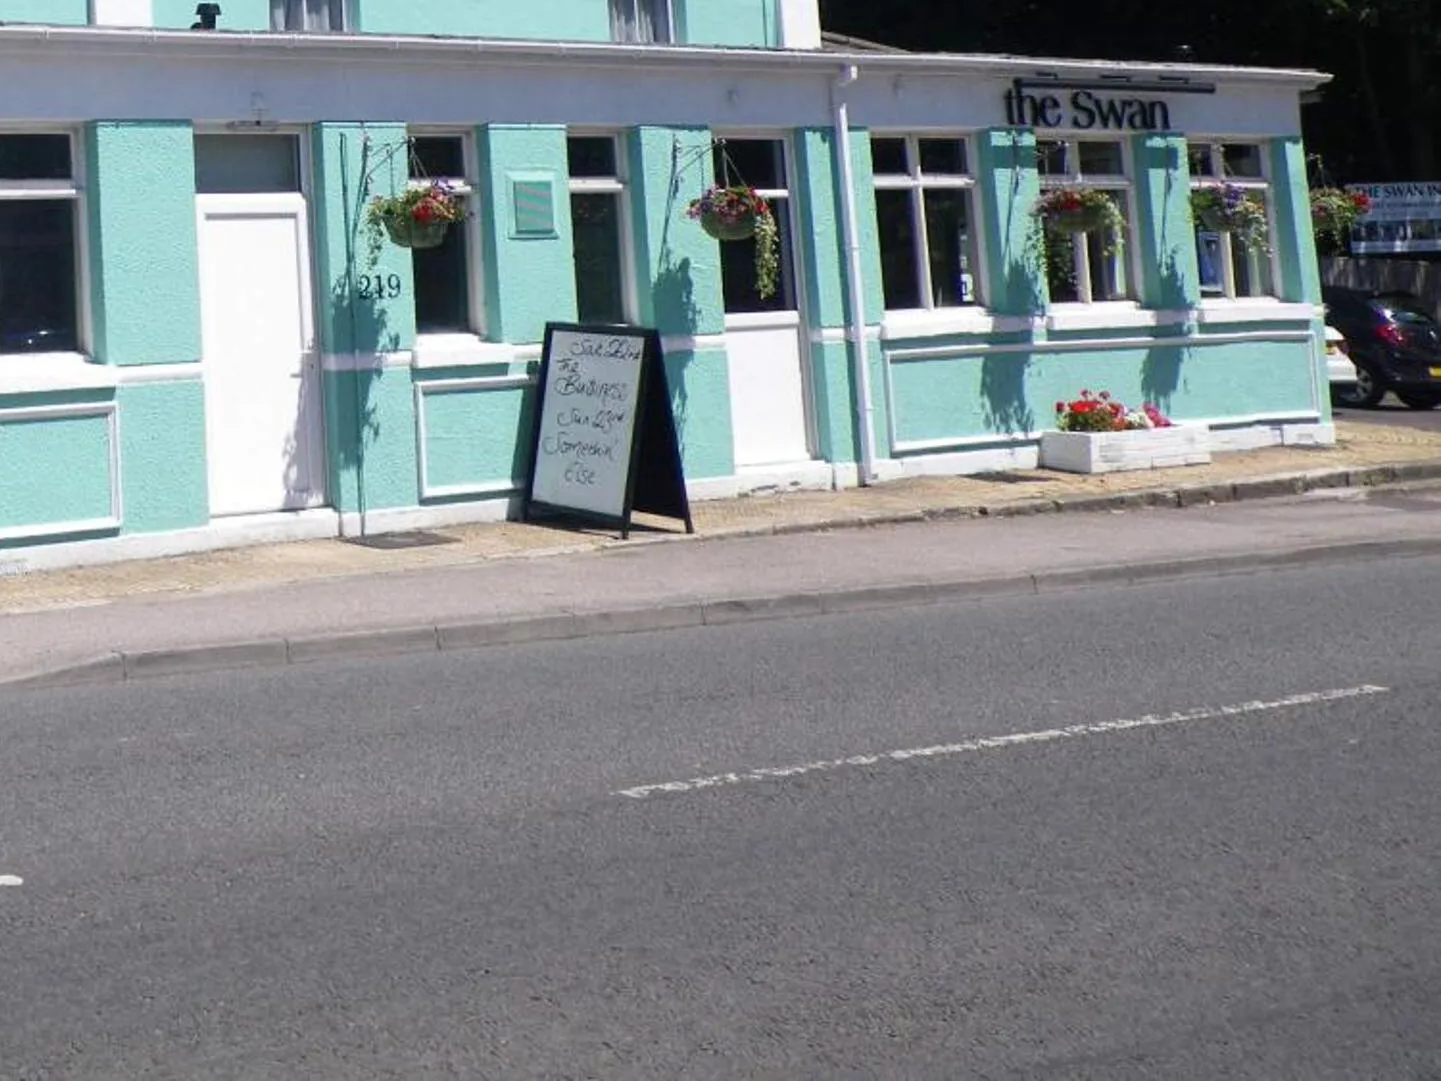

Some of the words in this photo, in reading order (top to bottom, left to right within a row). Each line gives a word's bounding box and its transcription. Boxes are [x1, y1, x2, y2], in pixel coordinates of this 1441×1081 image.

[1003, 82, 1062, 128] the
[1070, 89, 1171, 130] Swan
[1383, 184, 1425, 197] SWAN
[358, 273, 401, 300] 219
